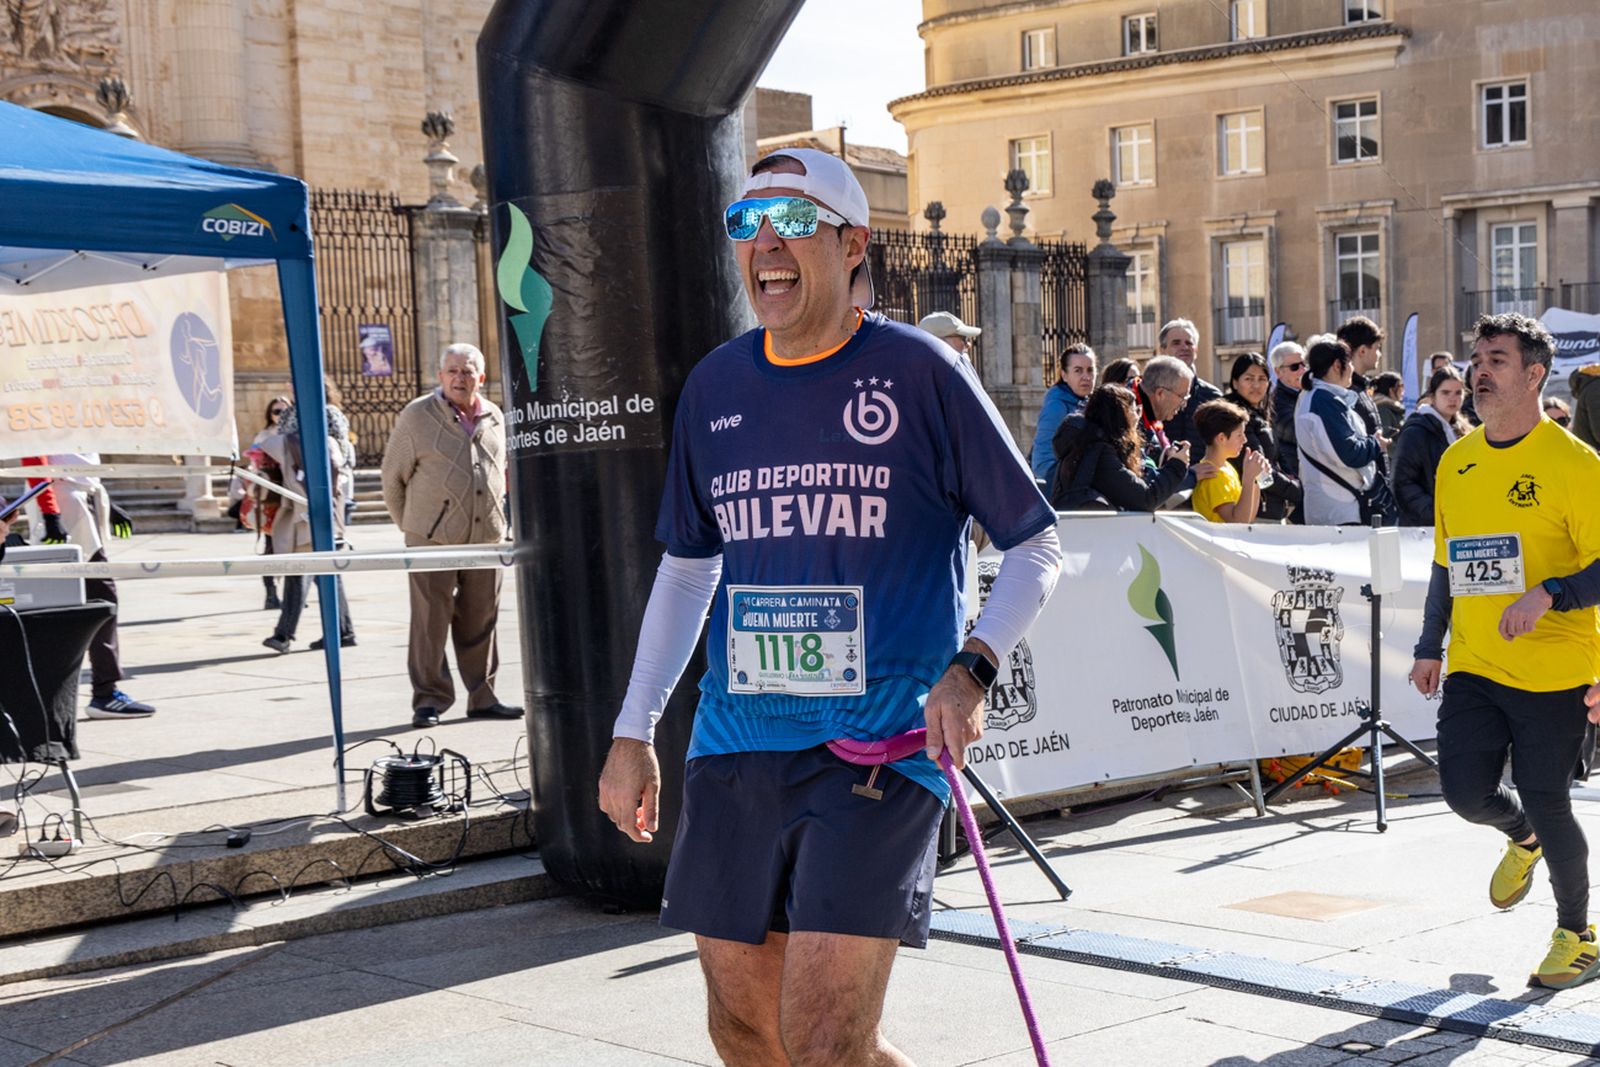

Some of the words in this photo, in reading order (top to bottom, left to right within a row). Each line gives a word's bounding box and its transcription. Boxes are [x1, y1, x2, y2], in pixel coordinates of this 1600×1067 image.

[202, 218, 264, 236] COBIZI
[526, 395, 619, 421] Municipal
[625, 393, 655, 414] de
[544, 425, 568, 444] de
[573, 420, 626, 443] Jaén
[710, 414, 743, 433] vive
[711, 469, 751, 498] CLUB
[757, 463, 891, 490] DEPORTIVO
[713, 494, 888, 543] BULEVAR
[1474, 548, 1498, 558] MUERTE
[1465, 560, 1503, 582] 425
[752, 597, 787, 607] CARRERA
[789, 597, 841, 607] CAMINATA
[742, 611, 770, 628] BUENA
[773, 612, 819, 628] MUERTE
[755, 633, 824, 672] 1118
[1112, 693, 1173, 714] Patronato
[1215, 688, 1230, 702] de
[1194, 706, 1220, 722] Jaén
[1270, 704, 1318, 723] CIUDAD
[1320, 702, 1338, 718] DE
[1008, 739, 1029, 758] DE
[1033, 730, 1070, 755] JAÉN
